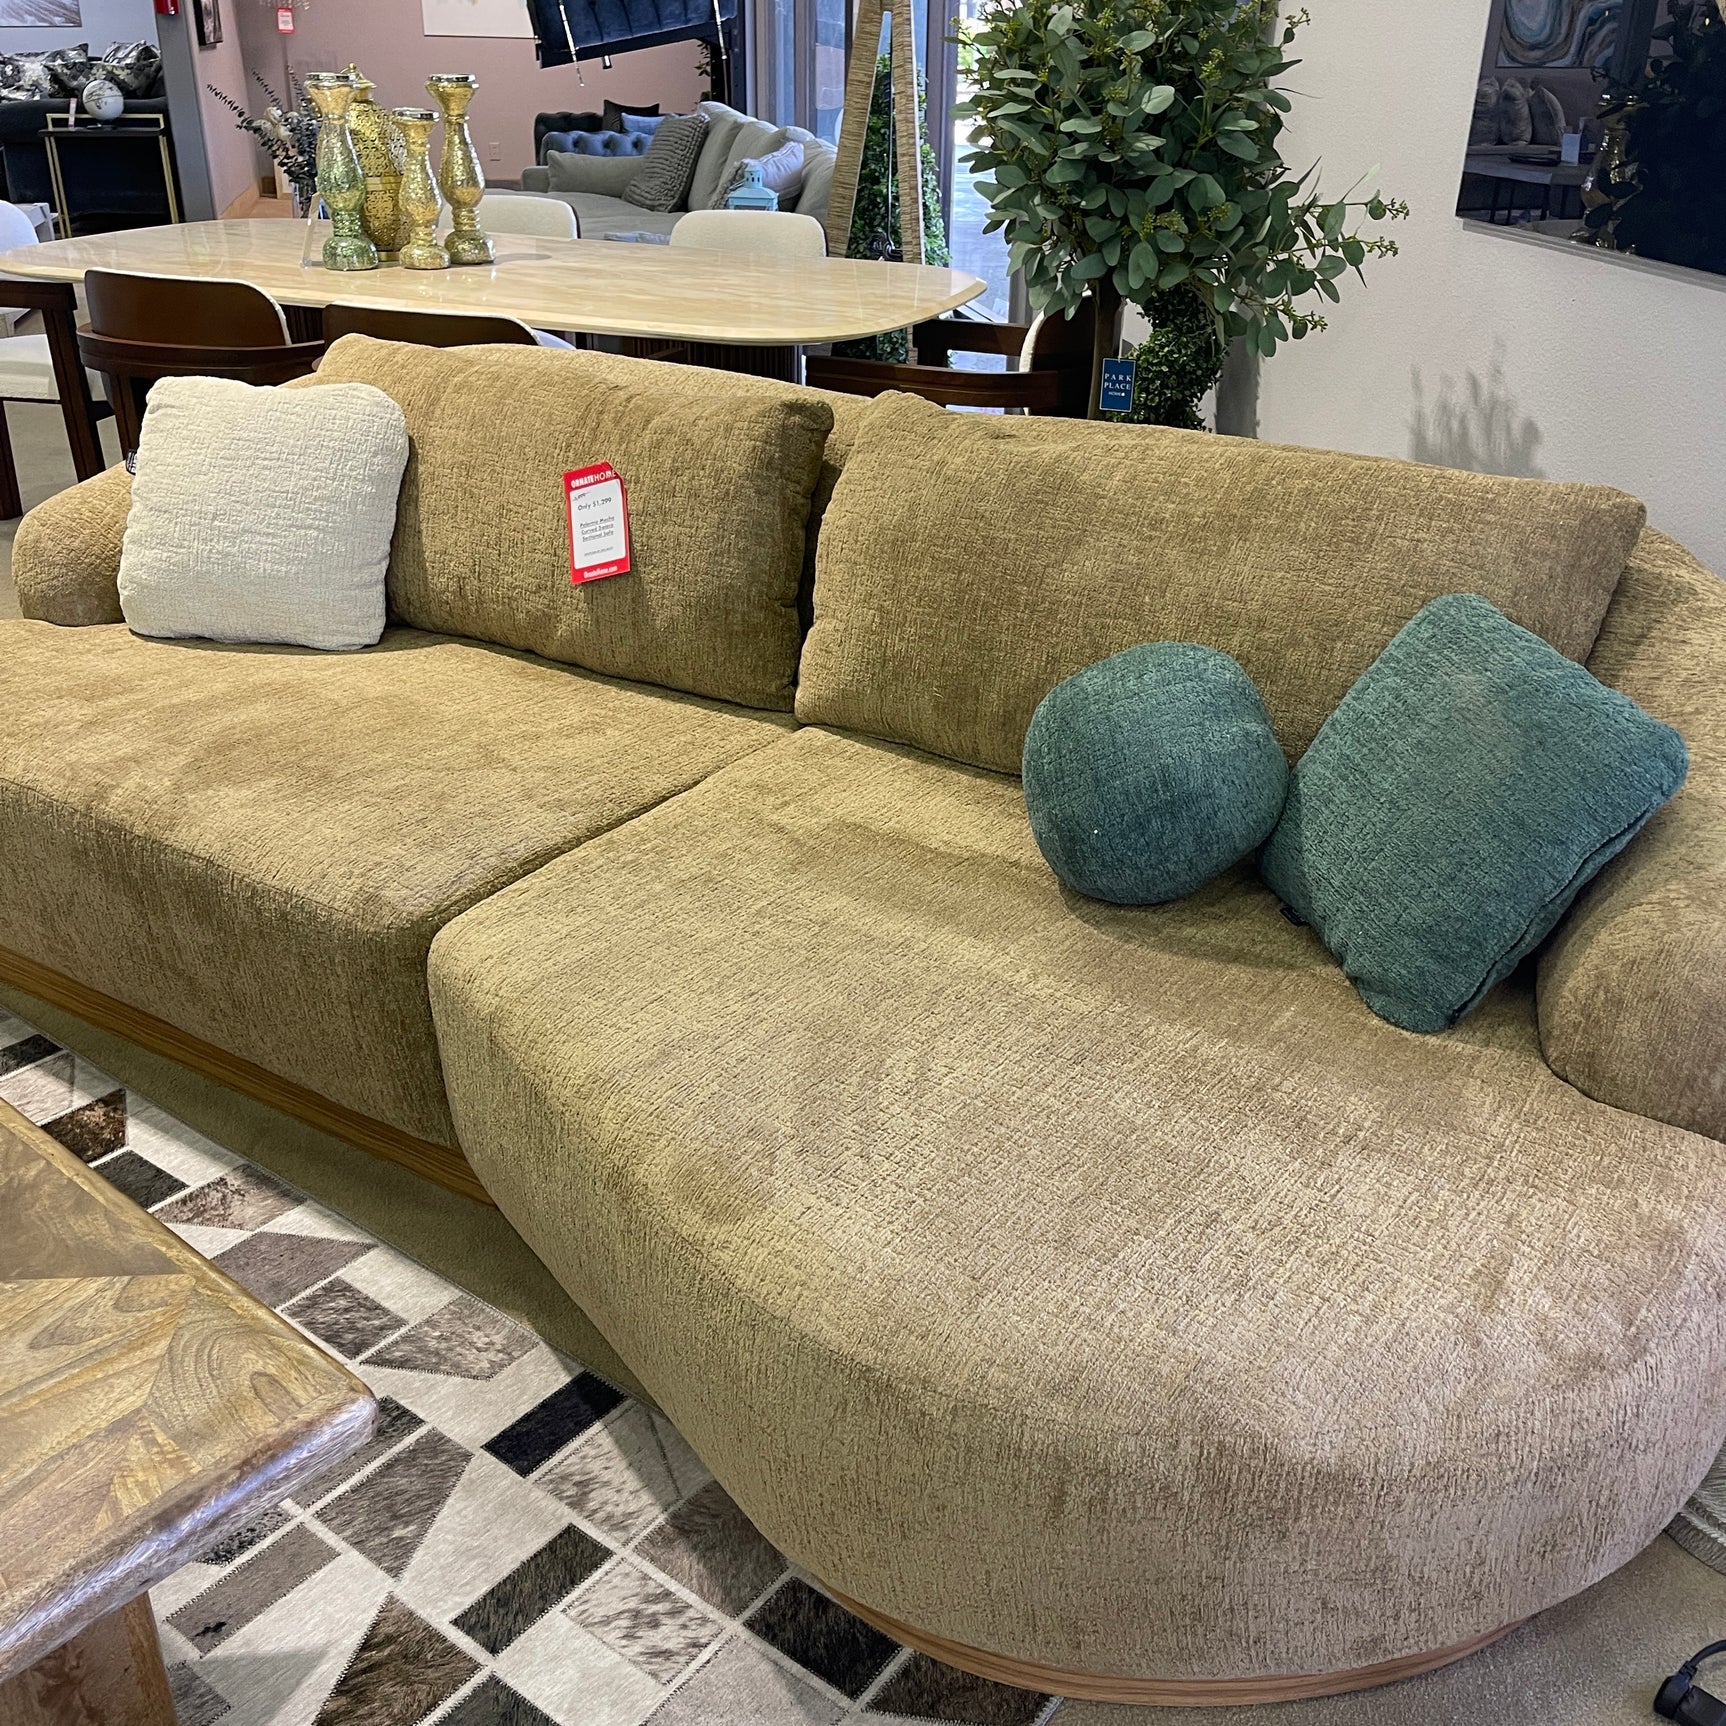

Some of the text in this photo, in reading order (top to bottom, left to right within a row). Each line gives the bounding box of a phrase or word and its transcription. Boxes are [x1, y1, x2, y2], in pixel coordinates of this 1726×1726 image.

[1104, 373, 1132, 381] PARK
[1104, 382, 1131, 390] PLACE
[578, 503, 591, 511] Only
[581, 527, 598, 535] Curved
[603, 529, 614, 537] Sofa
